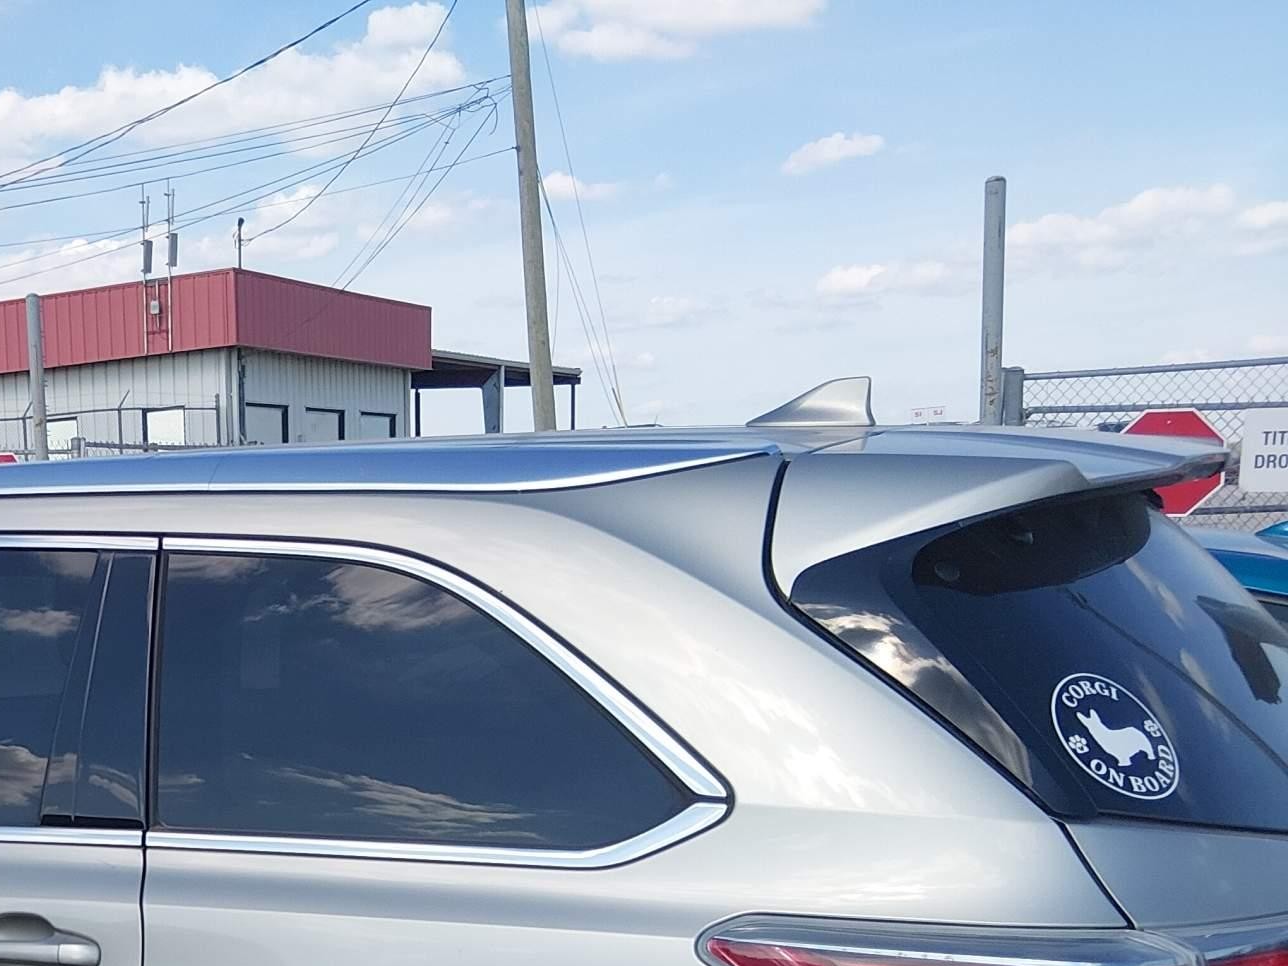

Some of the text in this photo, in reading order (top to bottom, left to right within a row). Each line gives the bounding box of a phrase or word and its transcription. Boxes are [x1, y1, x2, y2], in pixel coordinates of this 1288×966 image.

[1061, 680, 1120, 708] CORGI
[1089, 744, 1175, 793] ON BOARD
